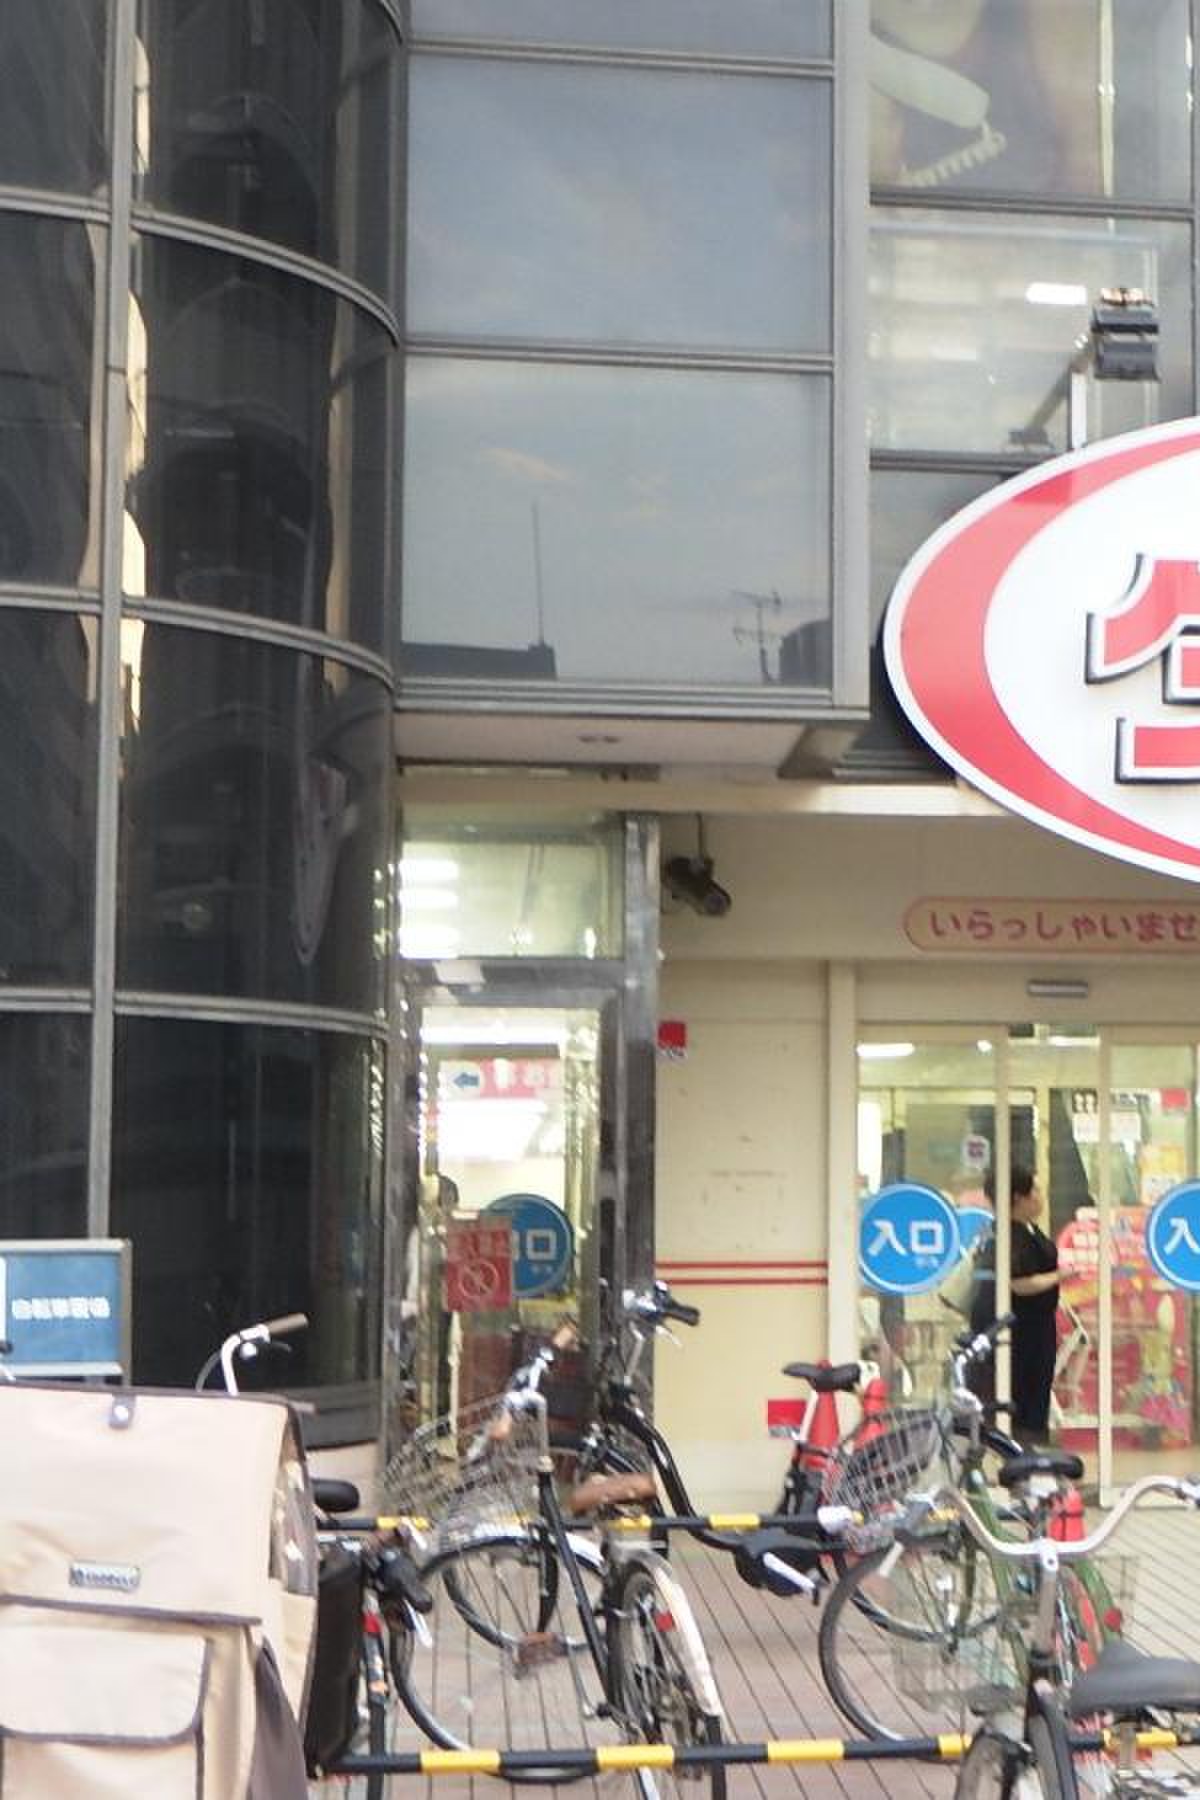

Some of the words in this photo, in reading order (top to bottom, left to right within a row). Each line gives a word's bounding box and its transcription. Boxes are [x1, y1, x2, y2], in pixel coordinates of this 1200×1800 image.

[930, 909, 1197, 942] いらっしゃいませ
[867, 1219, 945, 1256] 入口
